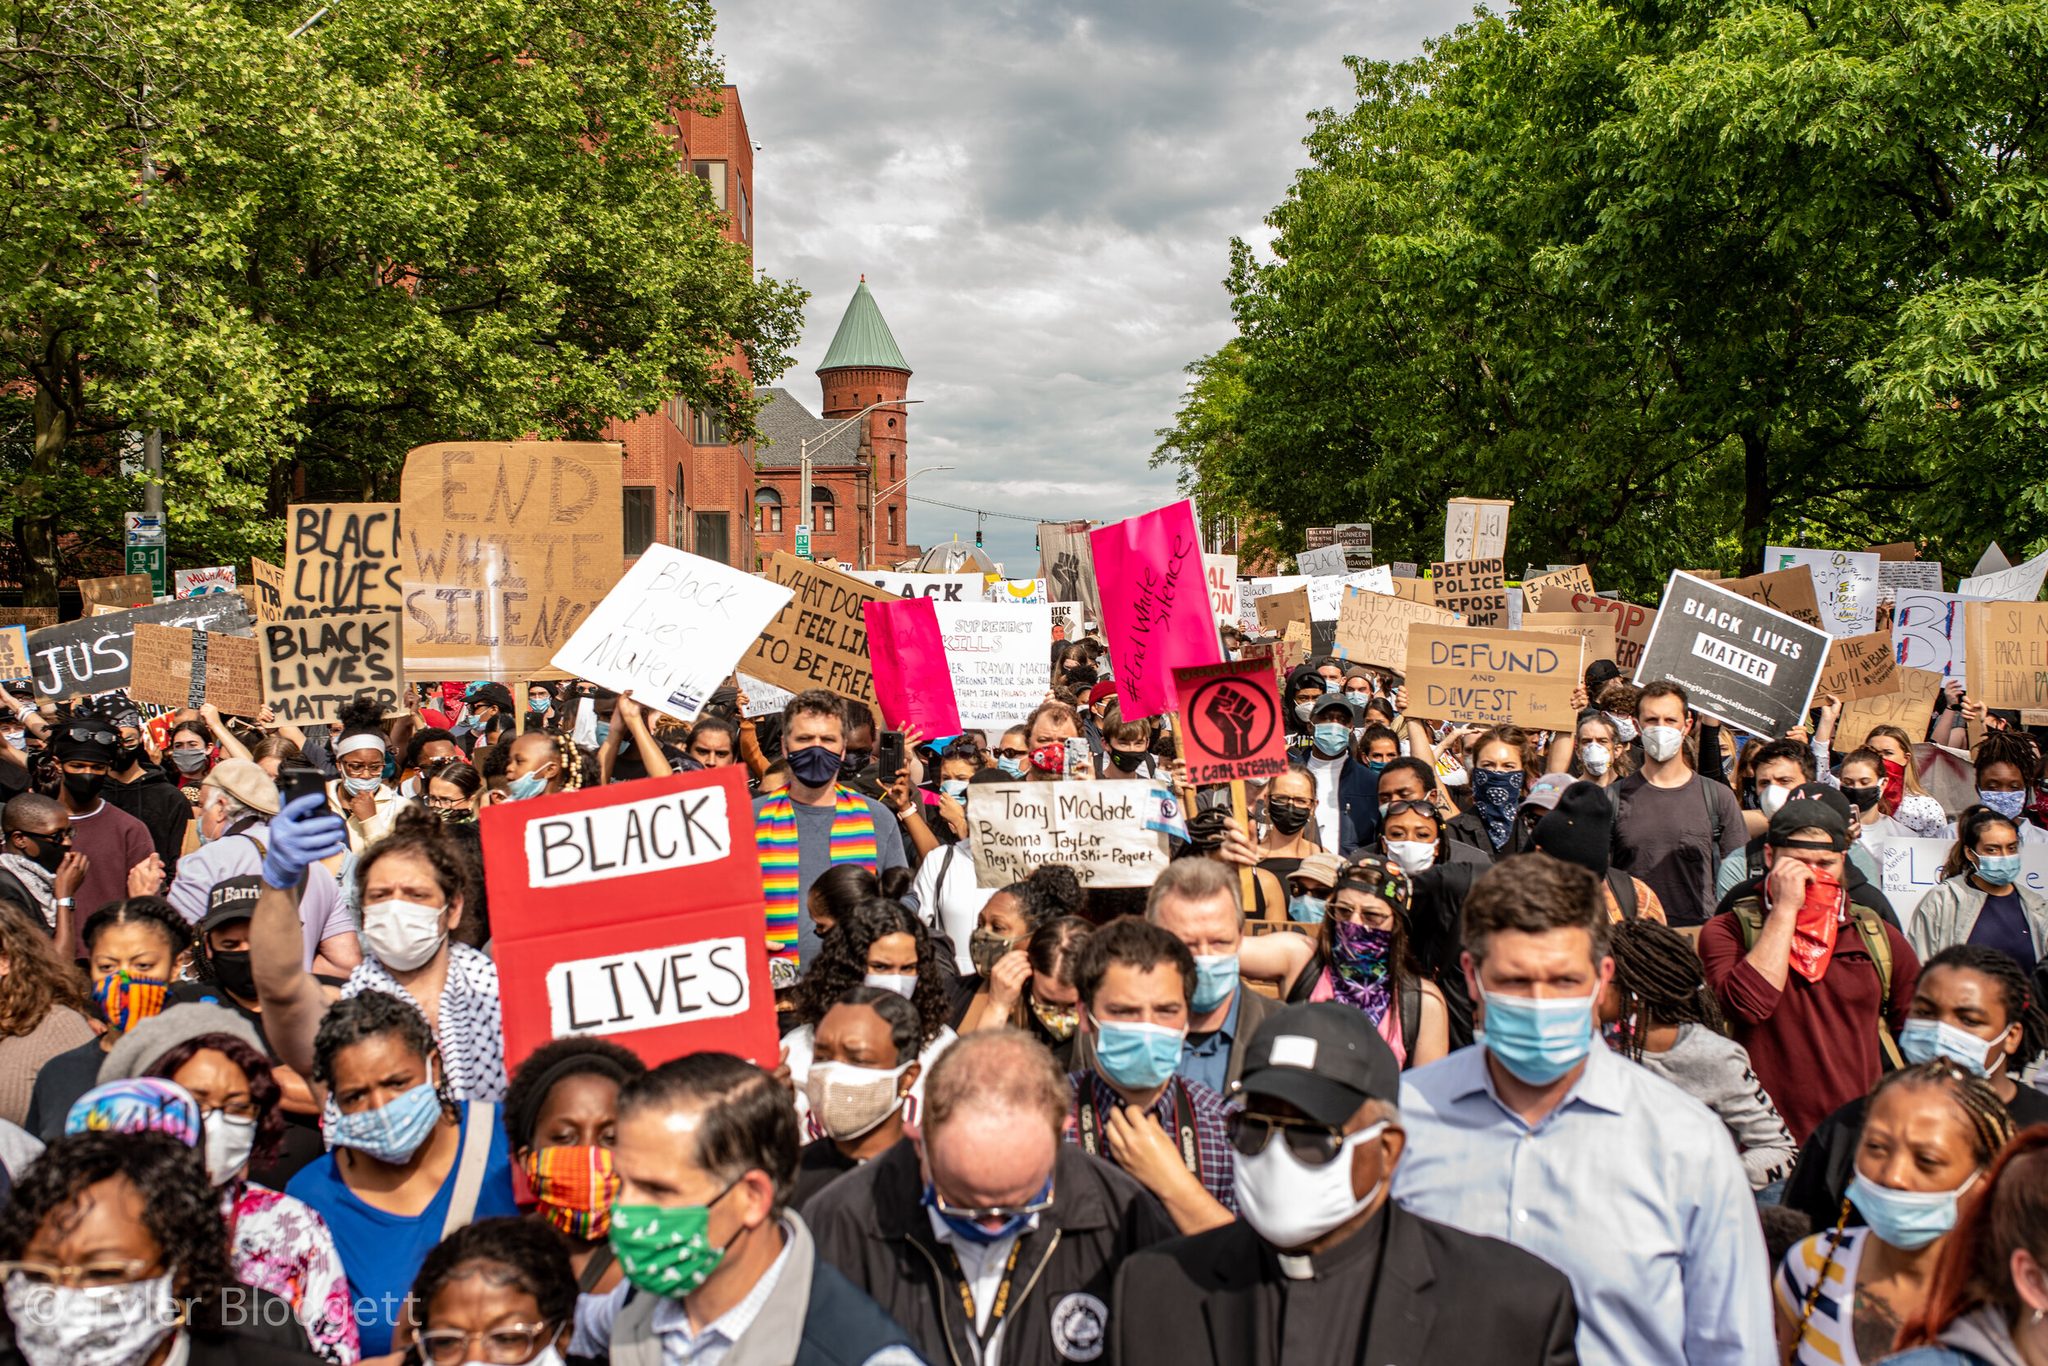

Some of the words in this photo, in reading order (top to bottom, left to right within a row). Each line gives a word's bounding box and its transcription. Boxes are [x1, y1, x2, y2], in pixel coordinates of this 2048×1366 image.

[442, 450, 599, 528] END
[410, 528, 606, 591] WHITE
[1302, 550, 1345, 575] BLACK
[1394, 563, 1416, 571] PAIN
[1433, 559, 1502, 578] DEFUND
[646, 561, 739, 620] Black
[776, 565, 833, 607] WHAT
[830, 586, 875, 622] DOE
[1154, 534, 1193, 633] Silence
[1243, 585, 1267, 596] Black
[1435, 576, 1504, 594] POLICE
[1526, 582, 1539, 593] I
[1968, 577, 1994, 597] NO
[1132, 567, 1158, 634] White
[1357, 592, 1394, 613] THEY
[1395, 599, 1432, 622] TRIED
[1436, 611, 1454, 626] TO
[1436, 595, 1505, 612] DEPOSE
[406, 588, 603, 648] SILENC
[623, 598, 699, 650] Lives
[777, 602, 793, 623] T
[795, 610, 838, 646] FEEL
[955, 620, 1033, 633] SUPREMACY
[1341, 606, 1379, 627] BURY
[1383, 614, 1409, 633] YOU
[1467, 613, 1498, 626] UMP
[1683, 597, 1744, 635] BLACK
[1752, 626, 1803, 660] LIVES
[2007, 610, 2022, 634] SI
[266, 621, 390, 662] BLACK
[942, 635, 1003, 653] KILLS
[1346, 623, 1409, 649] KNOWIN
[756, 632, 789, 664] TO
[793, 647, 828, 682] BE
[1431, 641, 1559, 674] DEFUND
[1701, 639, 1769, 680] MATTER
[1839, 640, 1868, 661] THE
[1860, 643, 1891, 672] #BLM
[1995, 641, 2024, 666] PARA
[2030, 641, 2043, 666] EL
[271, 653, 394, 692] LIVES
[955, 675, 987, 686] BREONNA
[989, 677, 1015, 686] TAYLOR
[1017, 677, 1034, 686] SEAN
[974, 661, 1014, 675] TRAYVON
[1119, 635, 1147, 703] #End
[1470, 674, 1496, 683] AND
[980, 689, 999, 698] JEAN
[1427, 685, 1518, 712] DIVEST
[1664, 673, 1776, 725] ShowingUpForRacialJustice.org
[1994, 670, 2030, 703] HAYA
[971, 711, 995, 720] GRANT
[1451, 710, 1474, 720] THE
[1478, 711, 1513, 724] POLICE
[1853, 694, 1923, 721] LOVE
[1190, 767, 1198, 783] I
[995, 789, 1049, 829] Tony
[540, 795, 722, 878] BLACK
[979, 820, 1042, 848] Breonna
[984, 848, 1018, 873] Regis
[1883, 847, 1898, 860] NO
[1885, 850, 1908, 872] Justice
[1888, 873, 1899, 882] NO
[224, 885, 263, 904] Barri
[566, 946, 744, 1031] LIVES
[1180, 1125, 1197, 1173] Canon
